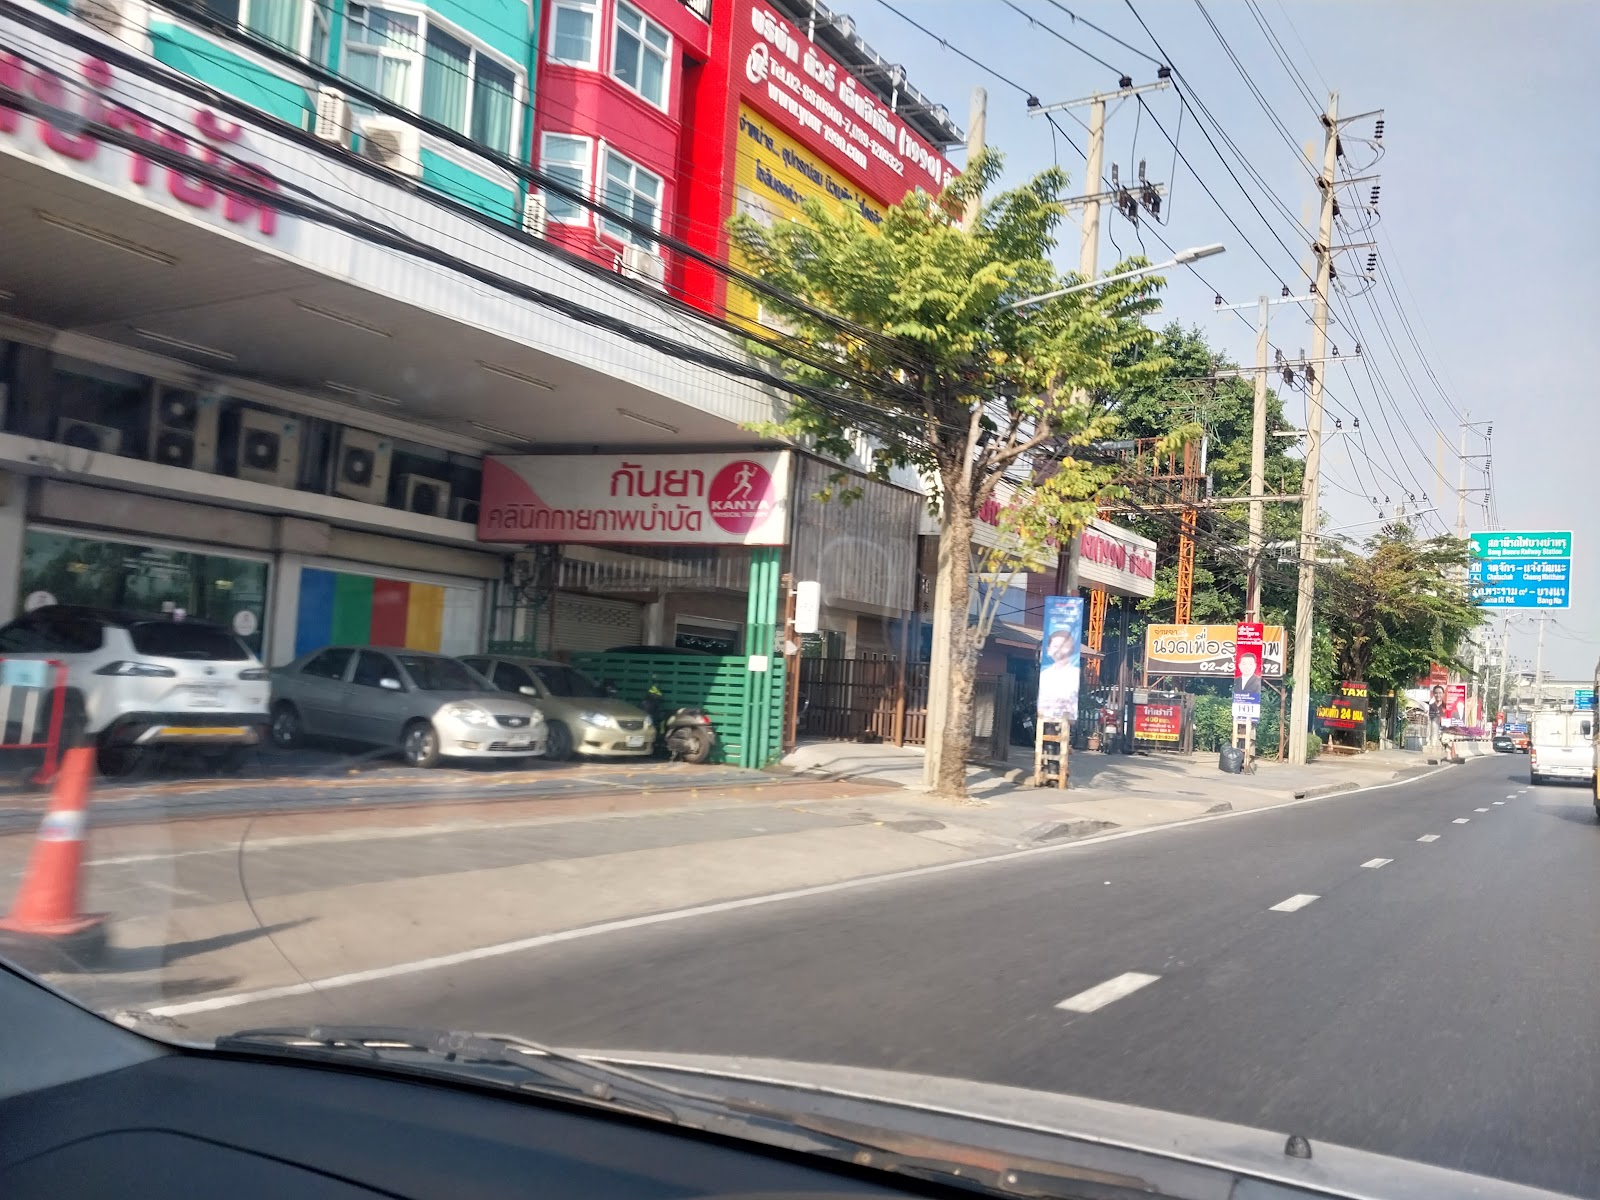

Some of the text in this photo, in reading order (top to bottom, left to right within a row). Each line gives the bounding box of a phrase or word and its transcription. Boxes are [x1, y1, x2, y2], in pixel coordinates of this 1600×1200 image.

[610, 461, 705, 498] กันยา
[711, 500, 770, 510] KANYA
[487, 502, 703, 533] คลินิกกายภาพบำบัด
[1536, 587, 1566, 596] บางนา
[1341, 687, 1368, 698] TAXI
[1340, 707, 1351, 720] 24
